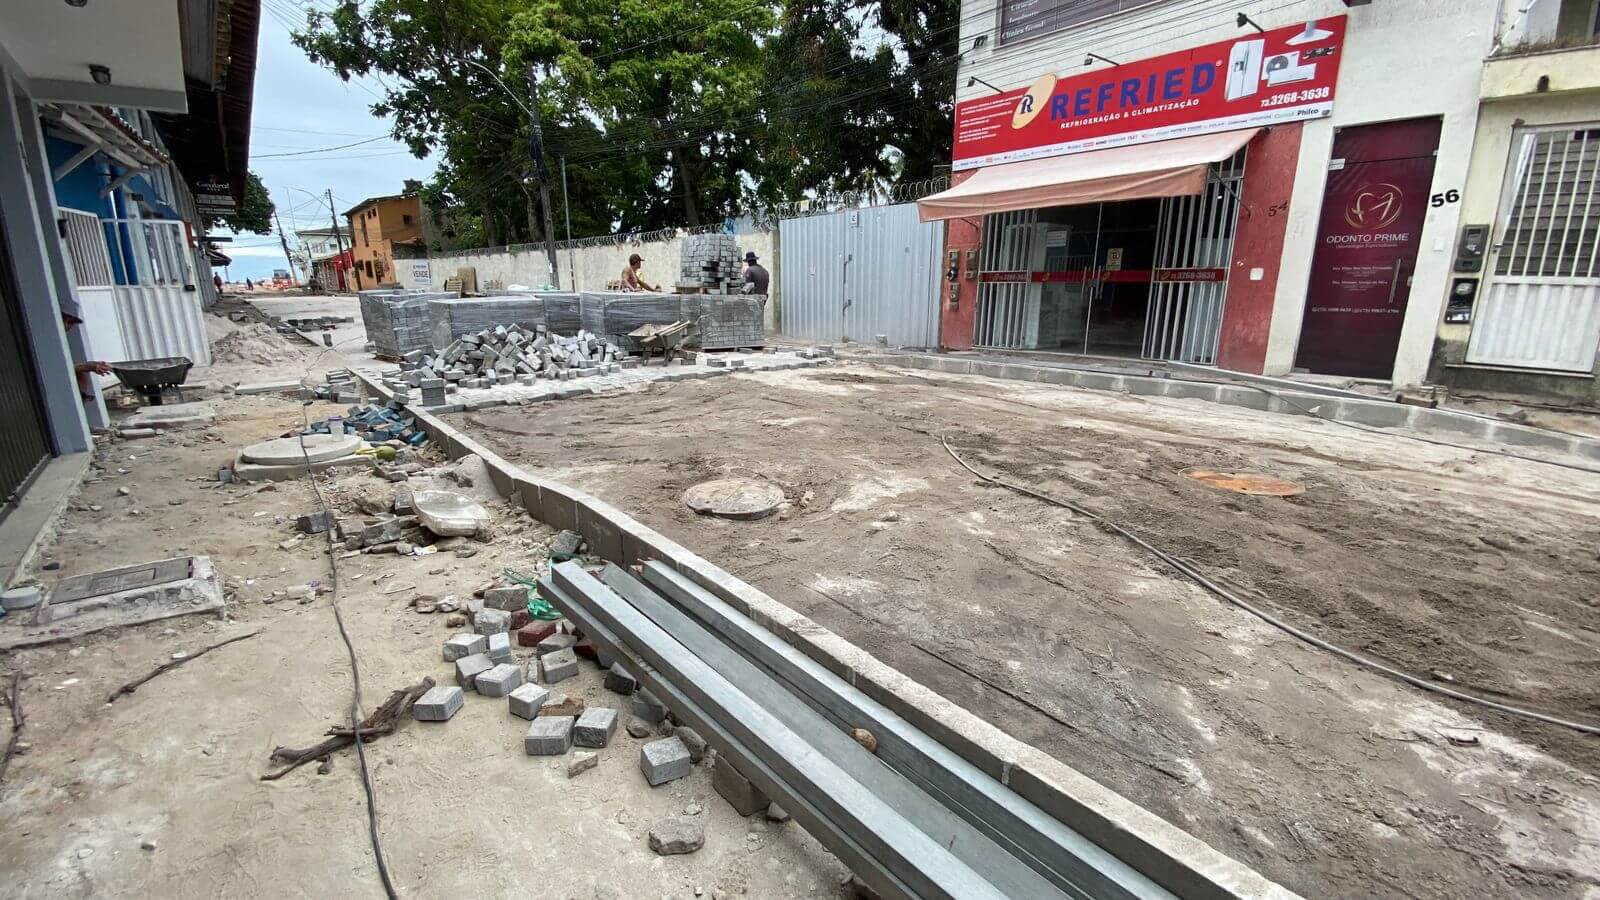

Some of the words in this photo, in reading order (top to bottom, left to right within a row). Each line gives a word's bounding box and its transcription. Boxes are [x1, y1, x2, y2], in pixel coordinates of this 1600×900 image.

[1051, 60, 1216, 121] REFRIED
[1060, 112, 1121, 129] REFRIGERAÇÃO
[1131, 98, 1200, 116] CLIMATIZAÇÃO
[1297, 108, 1319, 116] Philco
[1431, 189, 1460, 208] 56
[1326, 233, 1372, 244] ODONTO
[1374, 232, 1410, 242] PRIME
